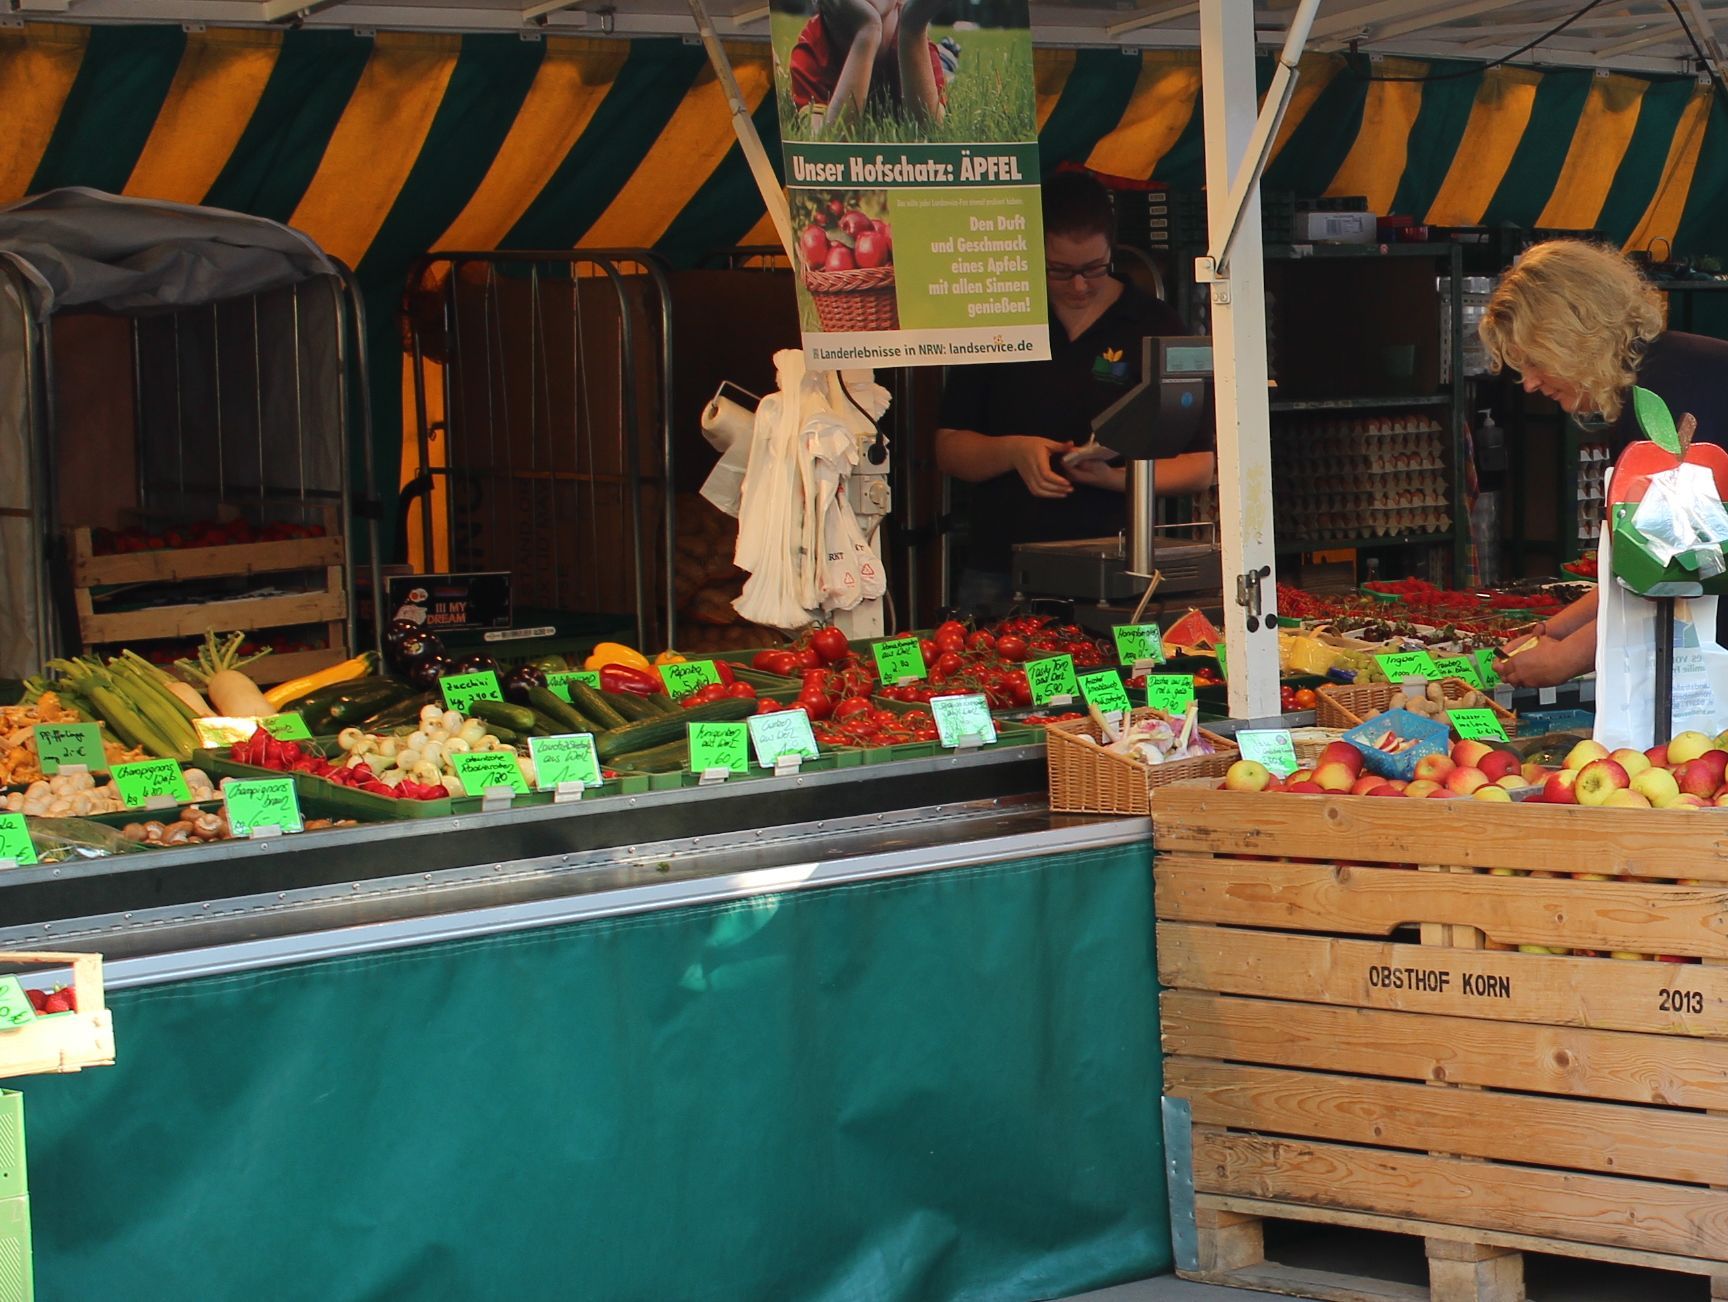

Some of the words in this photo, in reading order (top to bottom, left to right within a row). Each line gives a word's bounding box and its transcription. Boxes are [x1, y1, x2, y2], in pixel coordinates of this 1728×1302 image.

[793, 155, 844, 182] Unser
[850, 155, 954, 182] Hofschatz:
[960, 150, 1023, 181] ÄPFEL
[970, 216, 994, 231] Den
[998, 214, 1025, 230] Duft
[931, 237, 954, 253] und
[957, 235, 1027, 252] Geschmack
[952, 258, 984, 273] eines
[988, 256, 1028, 275] Apfels
[929, 279, 949, 295] mit
[952, 279, 983, 294] allen
[986, 278, 1030, 293] Sinnen
[968, 297, 1031, 318] genießen!
[821, 345, 901, 359] Landerlebnisse
[905, 344, 916, 356] in
[919, 344, 947, 355] NRW:
[950, 340, 1033, 354] landservice.de
[450, 602, 466, 612] MY
[427, 614, 466, 625] DREAM
[1386, 655, 1419, 667] Ingwer
[1028, 662, 1051, 680] Tasty
[446, 677, 489, 691] Zucchini
[117, 764, 174, 783] Champignons
[228, 782, 289, 802] Champignons
[1369, 966, 1449, 993] OBSTHOF
[1463, 972, 1511, 998] KORN
[1659, 989, 1704, 1014] 2013
